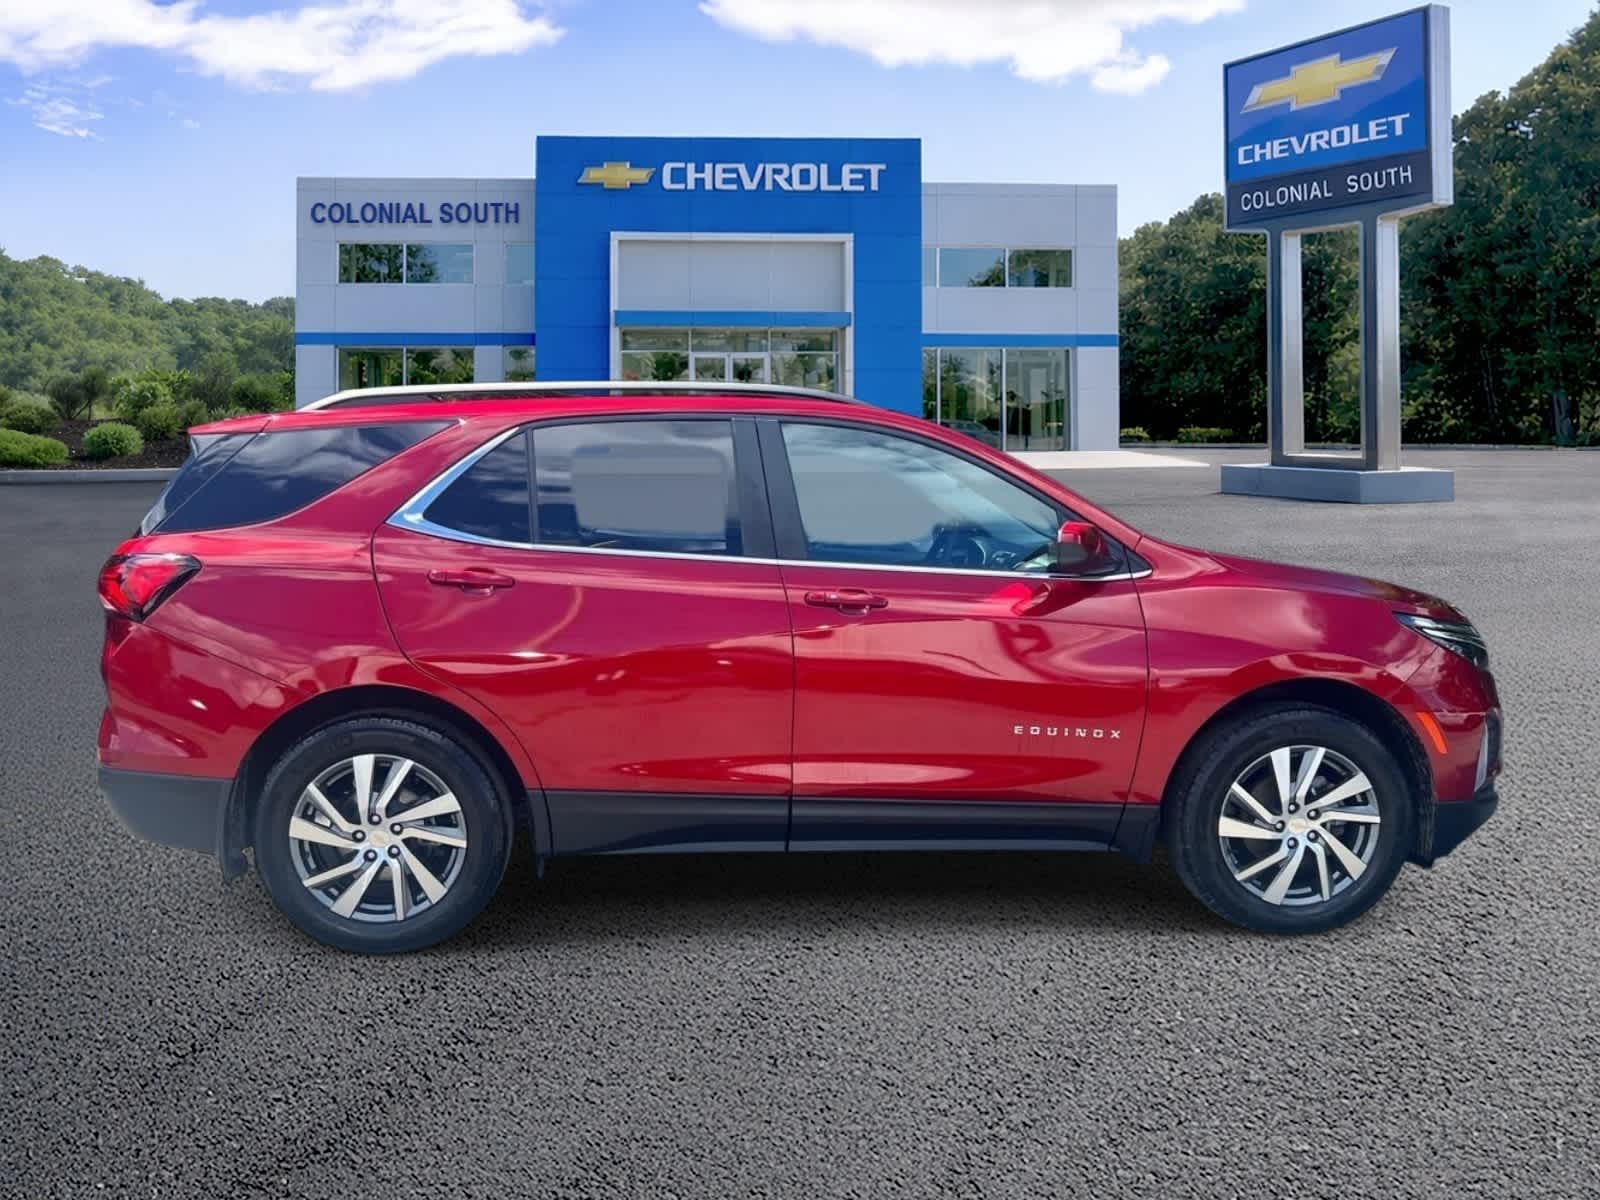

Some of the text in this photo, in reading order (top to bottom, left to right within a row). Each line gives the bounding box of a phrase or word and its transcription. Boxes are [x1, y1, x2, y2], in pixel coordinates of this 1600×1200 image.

[1237, 113, 1410, 165] CHEVROLET
[661, 162, 887, 193] CHEVROLET
[1240, 165, 1413, 212] COLONIAL SOUTH
[310, 202, 521, 225] COLONIAL SOUTH
[1013, 725, 1122, 739] EQUINOX
